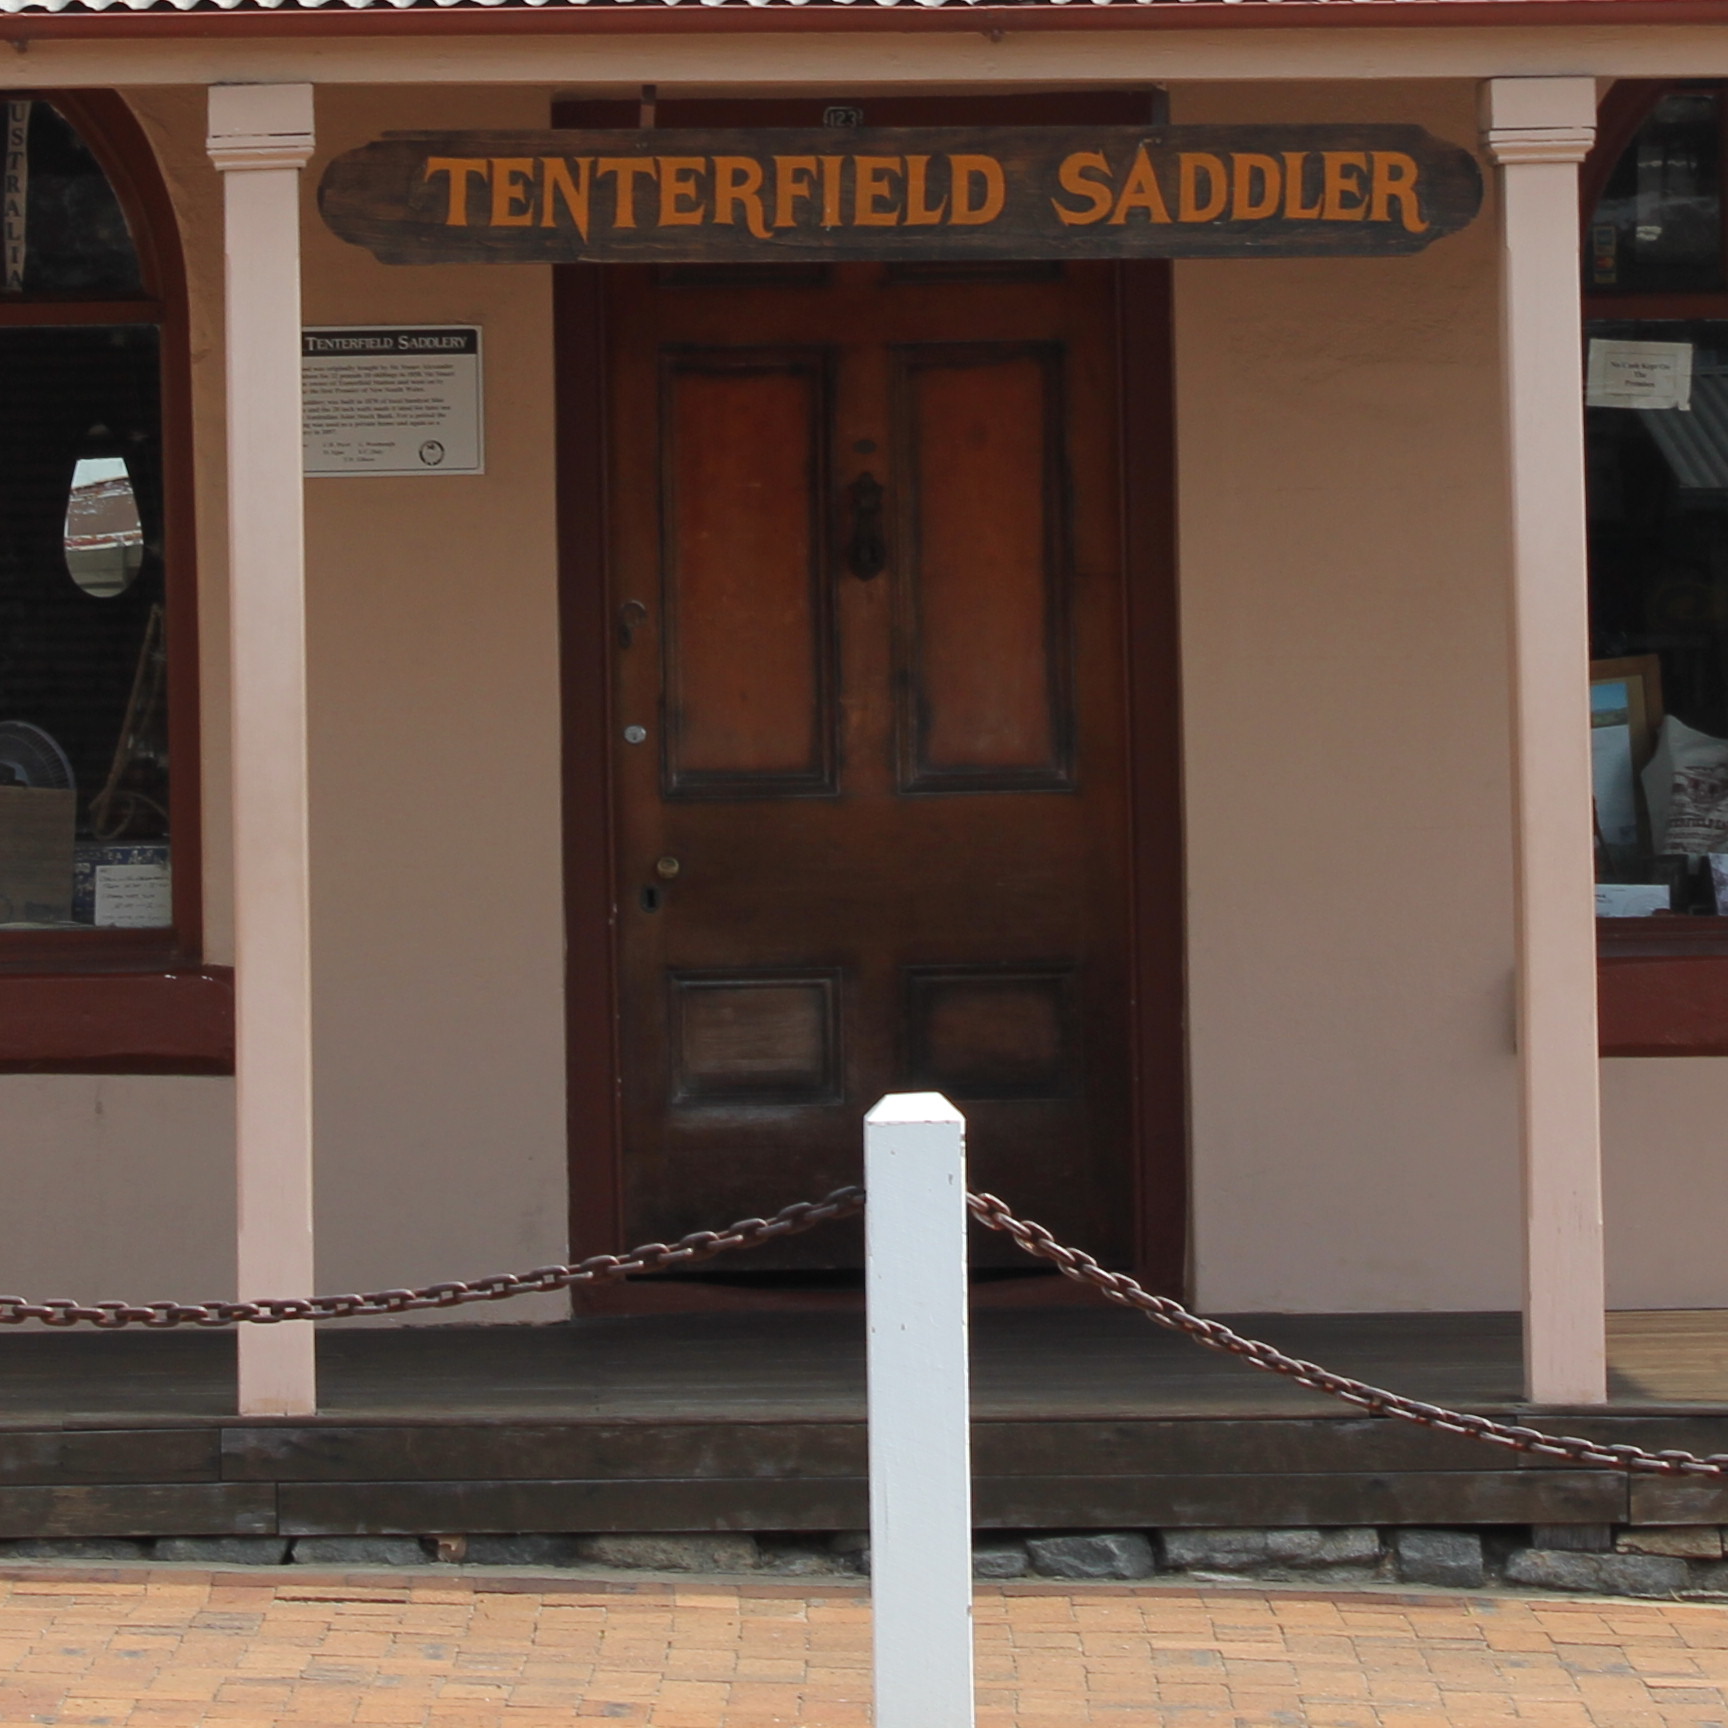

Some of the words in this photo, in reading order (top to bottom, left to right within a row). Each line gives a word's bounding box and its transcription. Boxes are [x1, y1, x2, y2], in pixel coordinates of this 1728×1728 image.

[5, 104, 26, 289] USTRALIA
[424, 153, 1006, 245] TENTERFIELD
[1050, 145, 1431, 234] SADDLER
[304, 336, 394, 351] TENTERFIELD
[397, 335, 468, 350] SADDLERY
